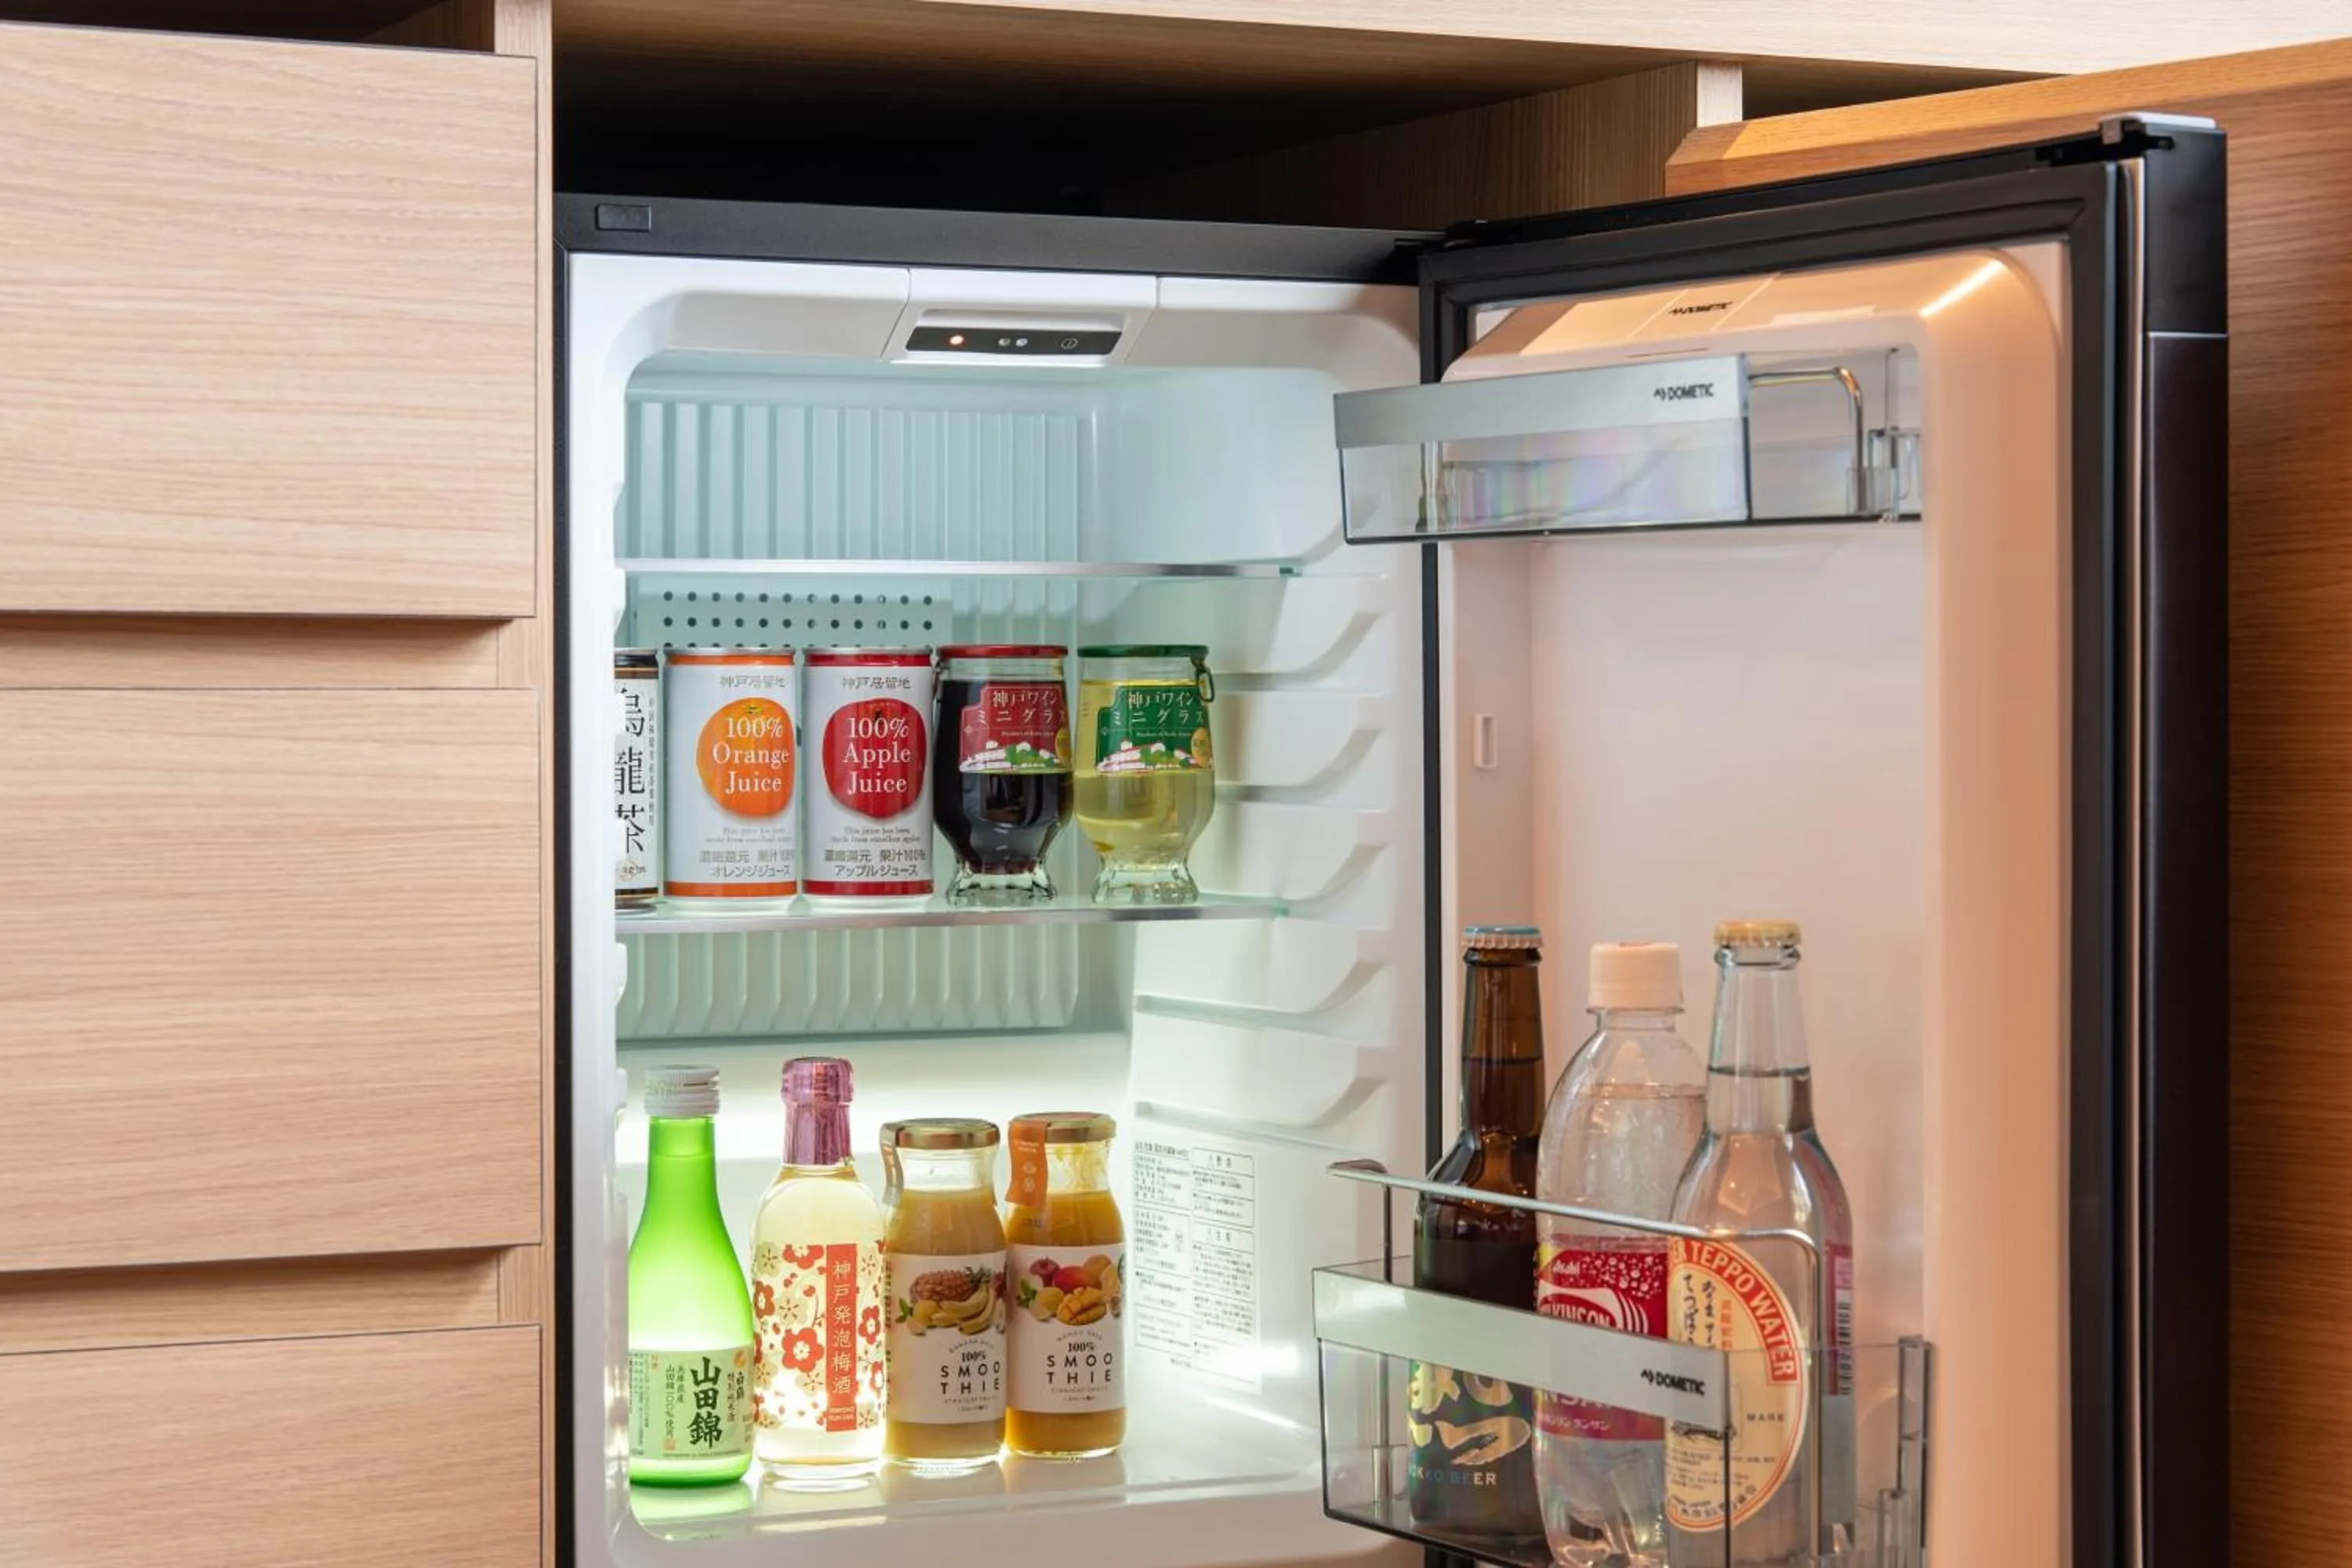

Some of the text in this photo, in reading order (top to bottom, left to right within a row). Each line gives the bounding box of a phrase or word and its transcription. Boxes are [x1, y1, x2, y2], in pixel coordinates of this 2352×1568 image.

[1668, 383, 1715, 401] DOMETIC
[842, 677, 912, 689] 神戸居留地
[993, 690, 1058, 707] 神戸ワイン
[1128, 691, 1194, 709] 神戸ワイン
[978, 708, 1065, 725] ミニグラス
[1113, 709, 1203, 725] ミニグラス
[727, 717, 782, 738] 100%
[848, 717, 909, 739] 100%
[713, 742, 789, 768] Orange
[842, 742, 911, 768] Apple
[726, 771, 782, 793] Juice
[848, 771, 907, 795] Juice
[711, 865, 791, 878] オレンジジュース
[835, 865, 918, 877] アップルジュース
[1690, 1241, 1755, 1294] TEPPO
[1749, 1290, 1795, 1377] WATER
[832, 1261, 852, 1394] 神戸発泡梅酒
[1067, 1341, 1096, 1352] 100%
[961, 1350, 987, 1363] 100%
[1656, 1371, 1705, 1396] DOMETIC
[688, 1356, 723, 1449] 山田錦
[1747, 1414, 1785, 1422] MARK
